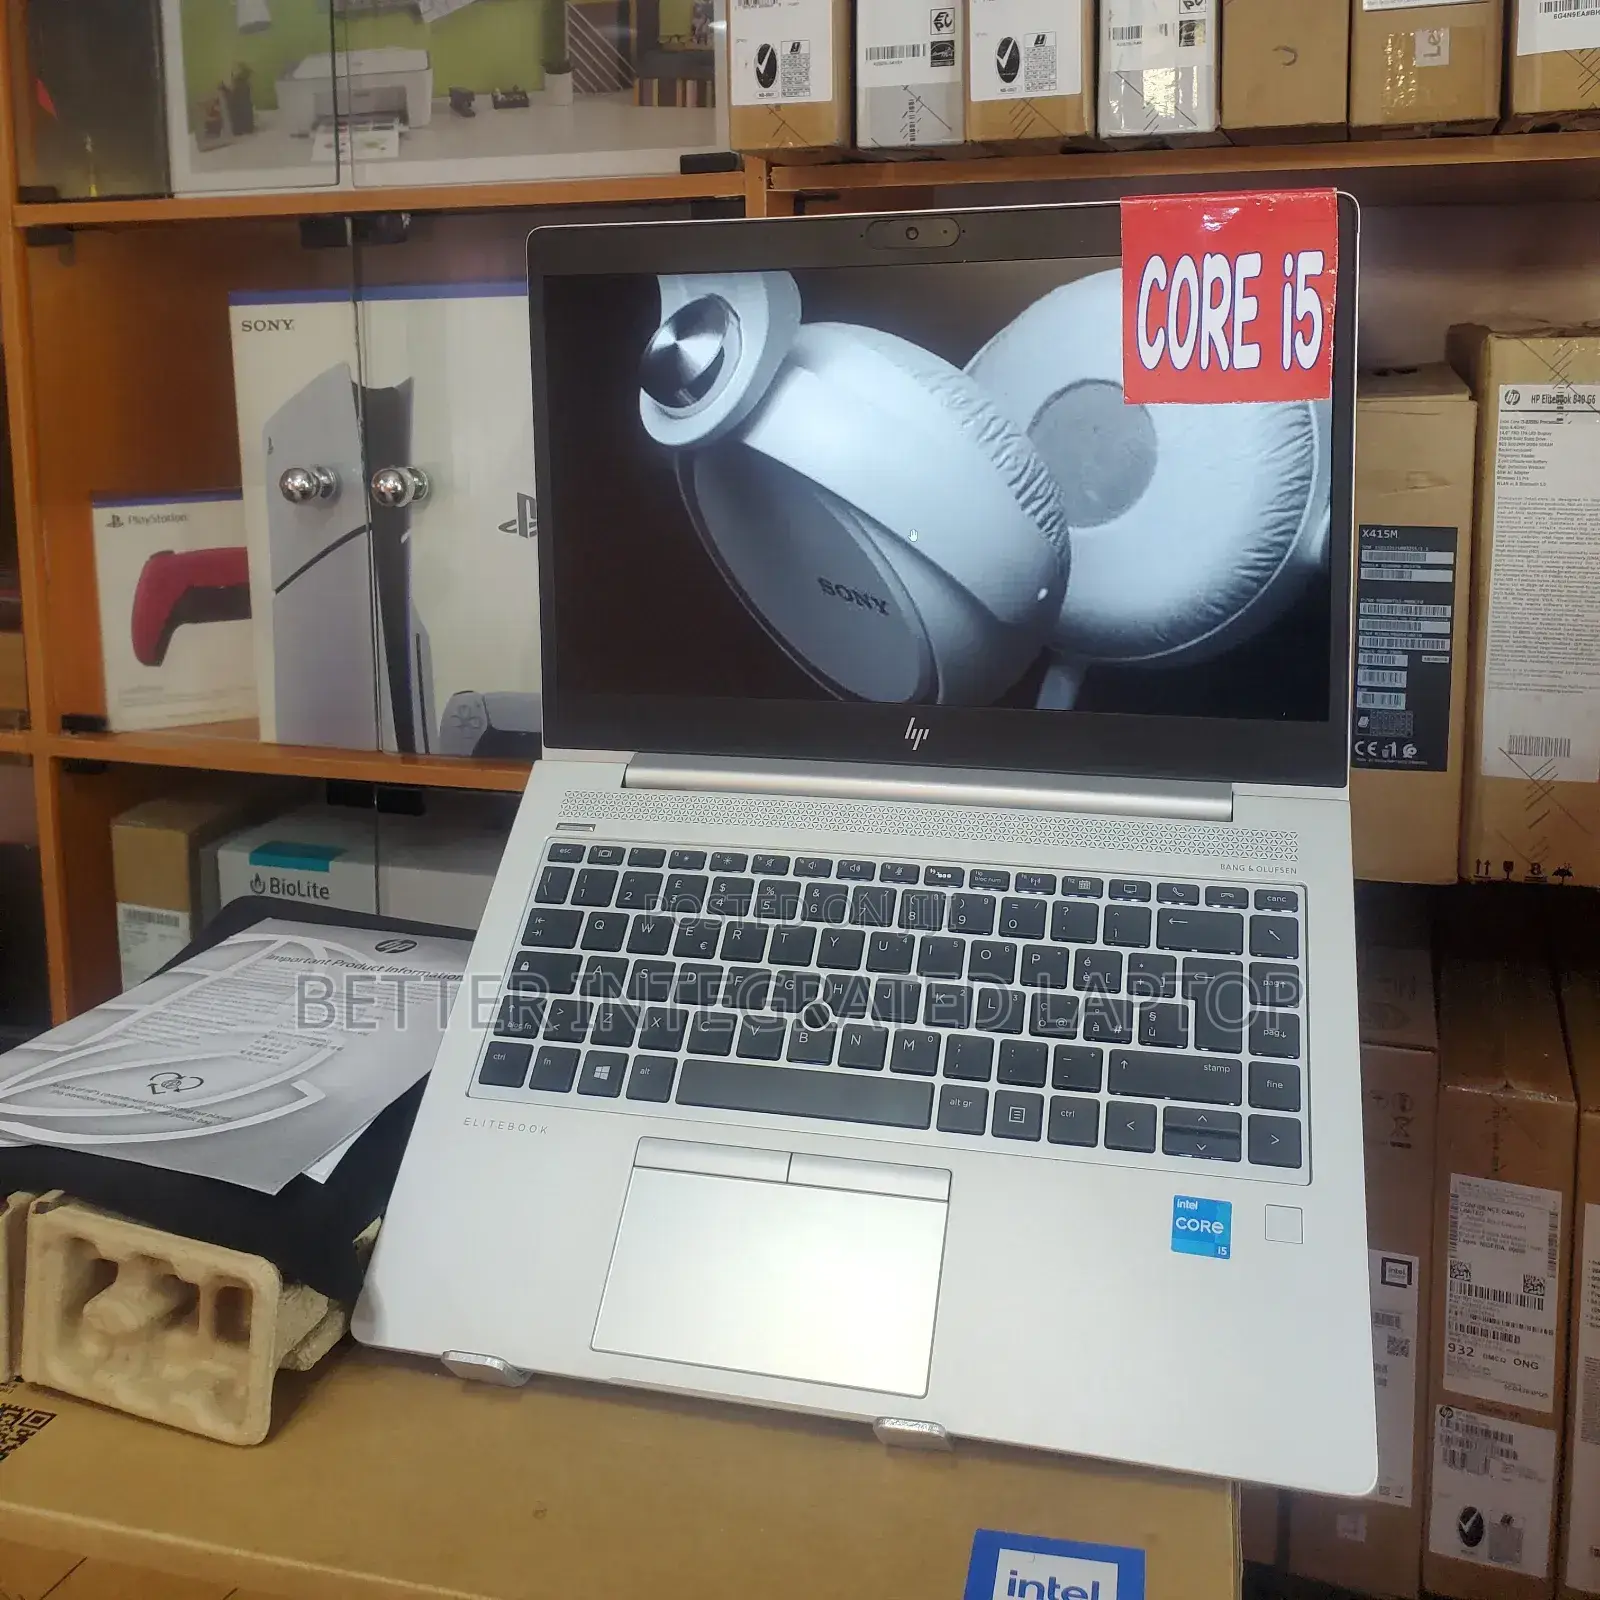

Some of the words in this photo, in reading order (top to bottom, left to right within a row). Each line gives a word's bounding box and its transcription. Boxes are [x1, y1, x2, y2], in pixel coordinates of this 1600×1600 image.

[1137, 253, 1262, 371] CORE
[1281, 251, 1324, 371] i5
[241, 319, 293, 332] SONY
[1531, 394, 1540, 404] HP
[1362, 529, 1398, 538] X415M
[817, 576, 889, 616] SONY
[1220, 863, 1246, 872] BANG
[1256, 866, 1297, 874] OLUFSEN
[270, 878, 330, 900] BioLite
[674, 880, 683, 889] £
[718, 883, 727, 893] $
[624, 892, 633, 900] 2
[766, 886, 775, 896] %
[812, 888, 821, 898] &
[670, 894, 678, 904] 3
[716, 898, 724, 906] 4
[762, 901, 770, 910] 5
[810, 904, 818, 913] 6
[1062, 906, 1070, 916] ?
[908, 912, 916, 921] 8
[958, 916, 966, 925] 9
[594, 920, 605, 931] Q
[640, 923, 655, 933] W
[685, 926, 695, 936] E
[732, 930, 742, 940] R
[780, 933, 789, 944] T
[830, 936, 840, 948] Y
[700, 942, 708, 950] €
[878, 941, 888, 951] U
[980, 950, 992, 960] O
[1031, 954, 1041, 964] P
[265, 953, 332, 966] Important
[332, 959, 386, 973] Product
[385, 965, 464, 981] Information
[592, 966, 602, 975] A
[640, 968, 648, 979] S
[687, 972, 696, 982] D
[734, 976, 743, 986] F
[784, 980, 795, 990] G
[833, 984, 843, 994] H
[884, 988, 891, 999] J
[936, 994, 946, 1004] K
[988, 998, 996, 1010] L
[602, 1013, 613, 1024] Z
[1149, 1012, 1156, 1022] §
[650, 1017, 662, 1028] X
[700, 1022, 710, 1032] C
[1056, 1018, 1068, 1028] @
[1092, 1022, 1100, 1032] à
[750, 1026, 760, 1036] V
[1114, 1025, 1122, 1034] #
[1264, 1029, 1280, 1038] pag
[799, 1033, 809, 1043] B
[850, 1034, 862, 1046] N
[903, 1039, 915, 1051] M
[493, 1053, 506, 1061] ctrl
[543, 1057, 552, 1066] fn
[640, 1067, 650, 1076] alt
[1204, 1063, 1230, 1074] stamp
[1266, 1080, 1284, 1089] fine
[950, 1098, 961, 1107] alt
[962, 1100, 972, 1108] gr
[1060, 1110, 1076, 1118] ctrl
[464, 1117, 549, 1134] ELITEBOOK
[1176, 1199, 1198, 1210] intel
[1448, 1342, 1474, 1358] 932
[1514, 1358, 1538, 1370] ONG
[1007, 1570, 1100, 1600] intel
